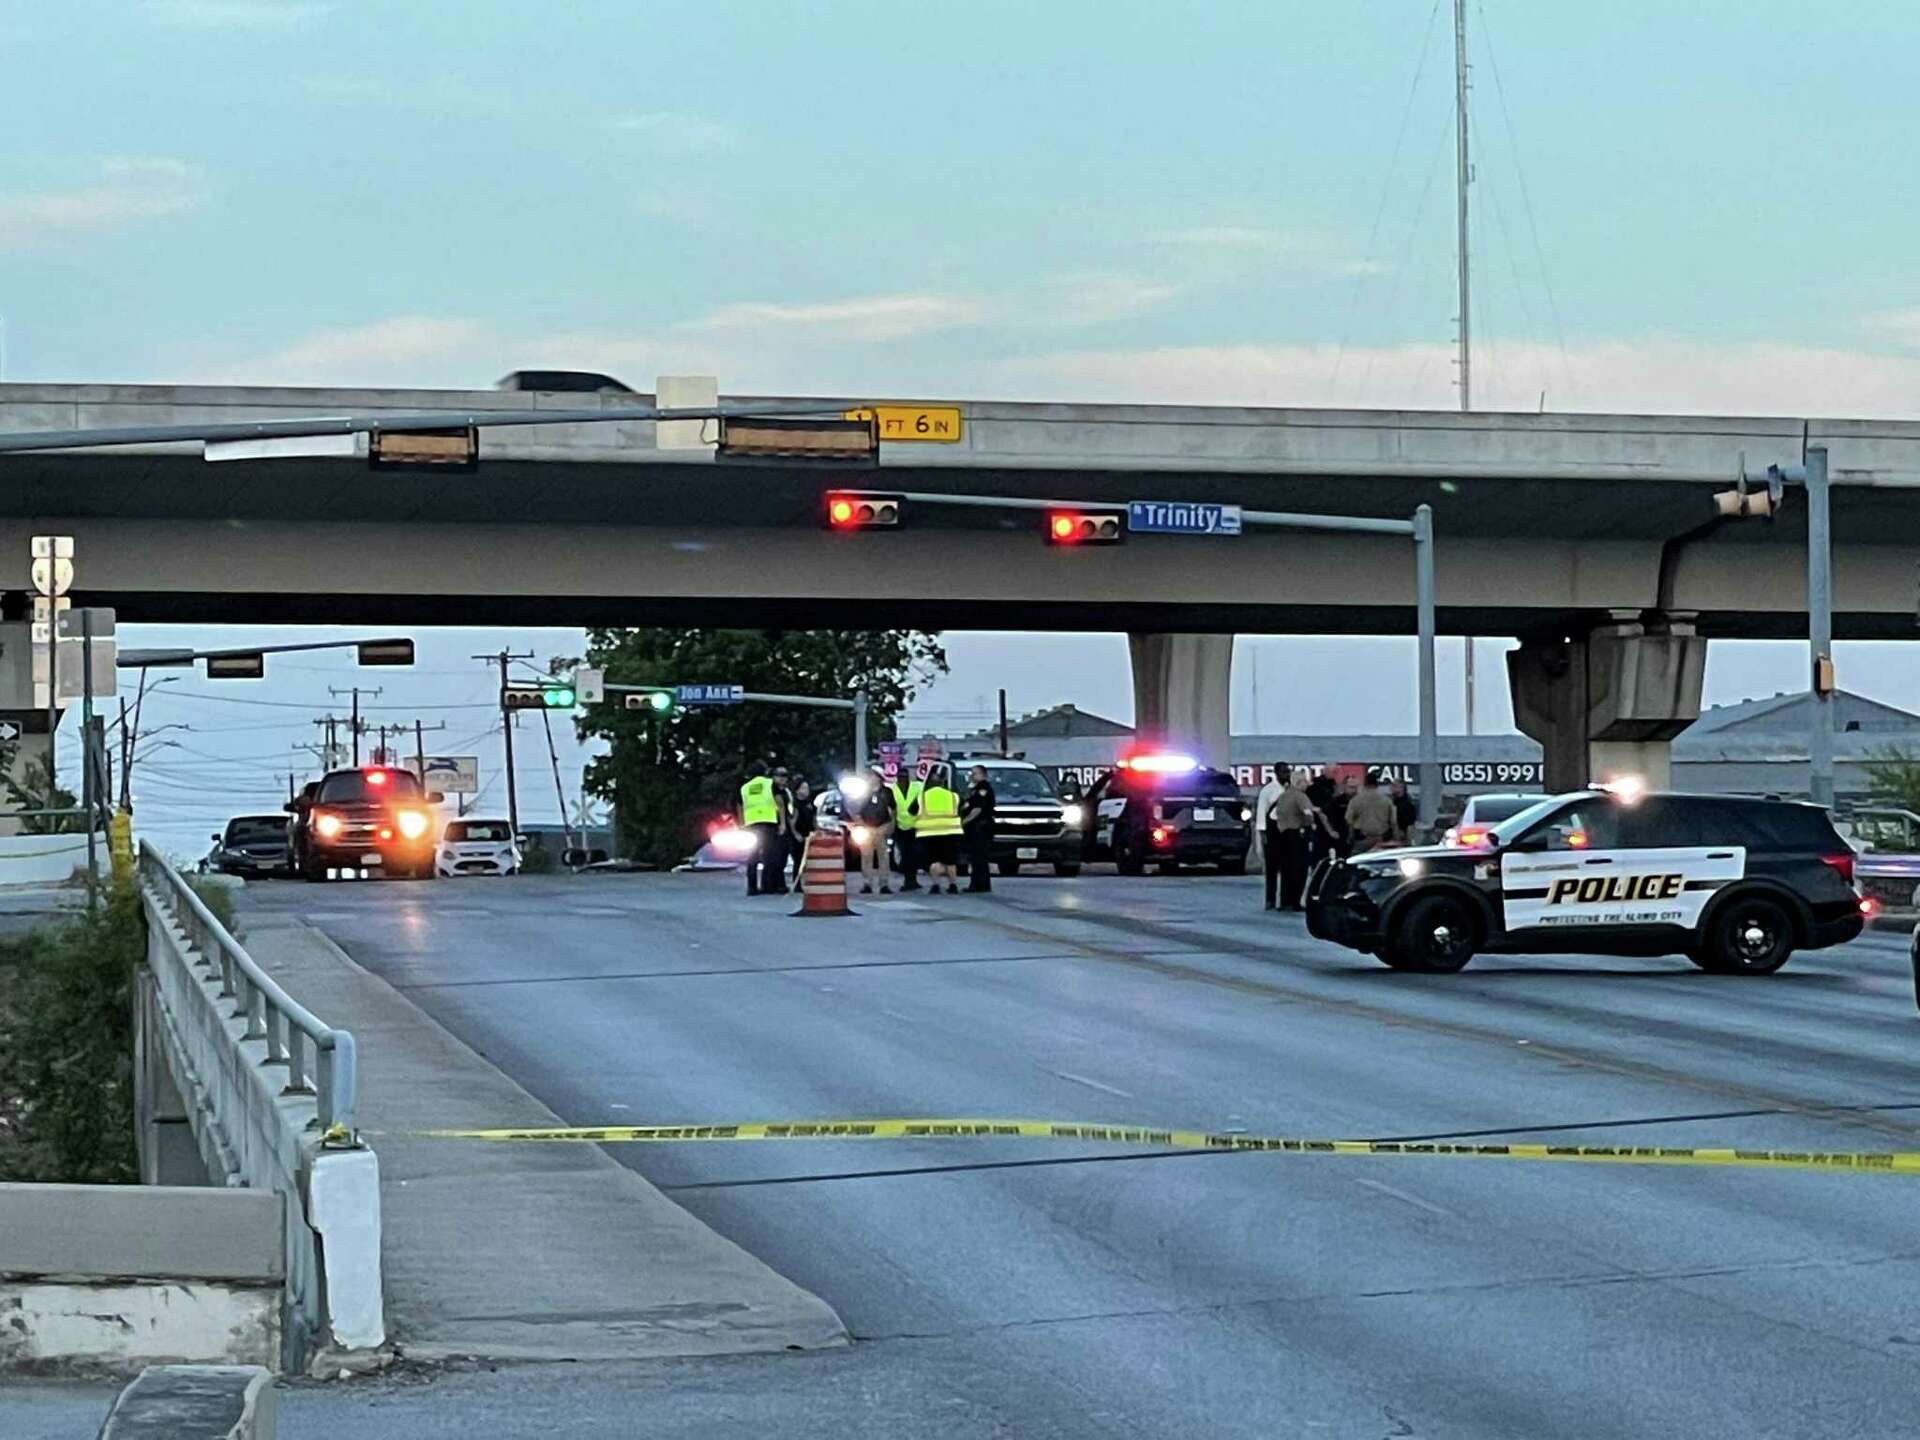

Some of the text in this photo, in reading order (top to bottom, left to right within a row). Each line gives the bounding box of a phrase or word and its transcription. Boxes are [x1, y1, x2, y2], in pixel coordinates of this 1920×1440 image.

[886, 415, 949, 434] FT 6 IN
[1146, 503, 1219, 533] Trinity
[1444, 764, 1492, 783] (855)
[1497, 764, 1534, 783] 999
[1547, 873, 1683, 905] POLICE
[1603, 913, 1623, 922] THE
[1660, 910, 1683, 919] CITY
